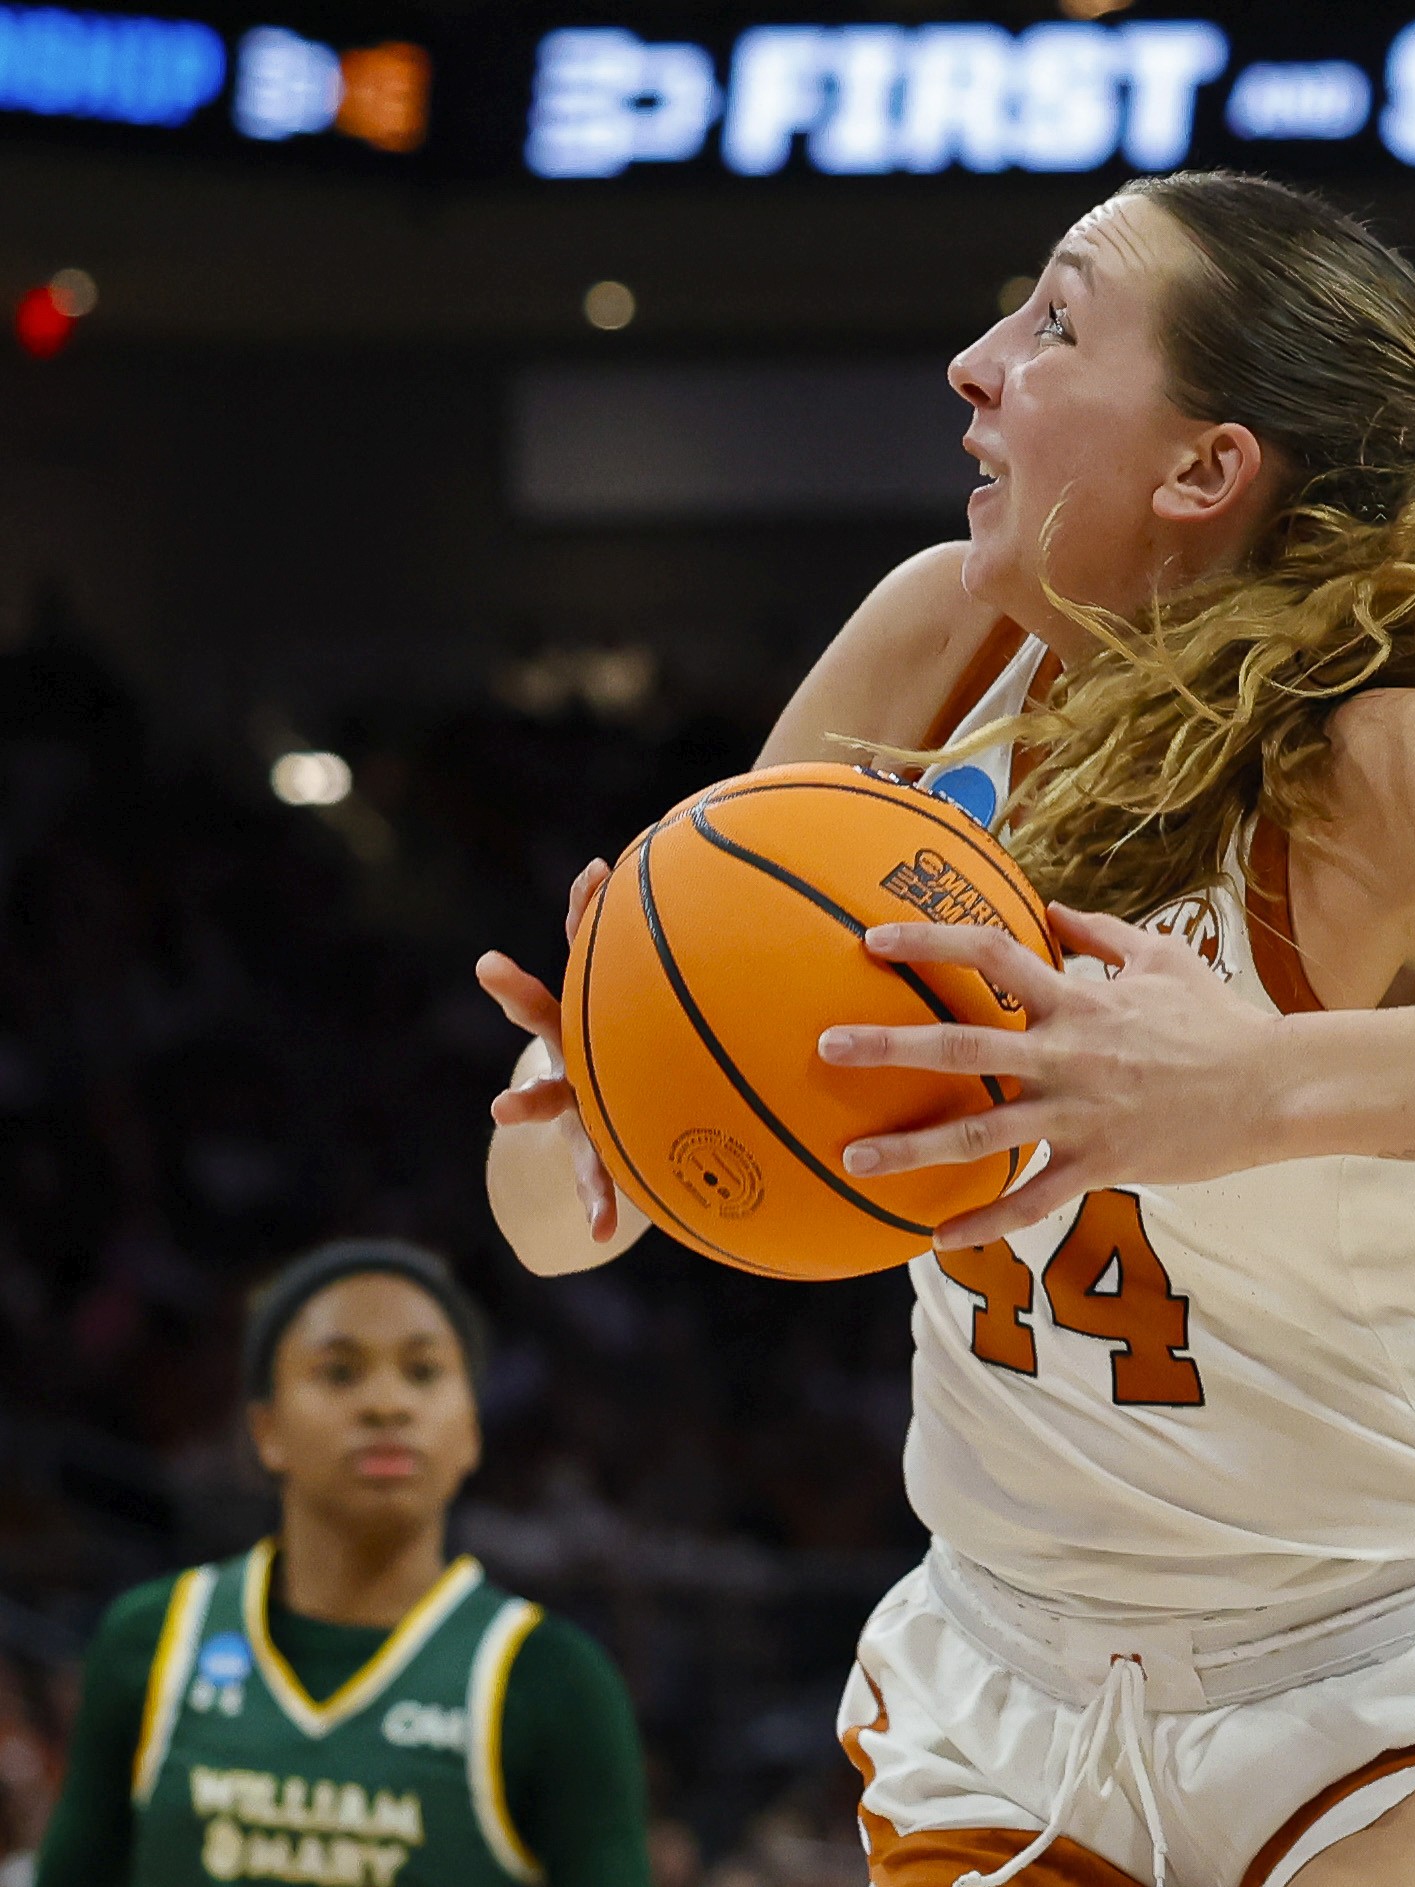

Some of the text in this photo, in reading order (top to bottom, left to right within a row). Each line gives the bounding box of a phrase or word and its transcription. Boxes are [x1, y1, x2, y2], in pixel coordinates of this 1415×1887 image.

[722, 20, 1229, 175] FIRST
[934, 1186, 1205, 1407] 44
[189, 1765, 426, 1847] WILLIAM
